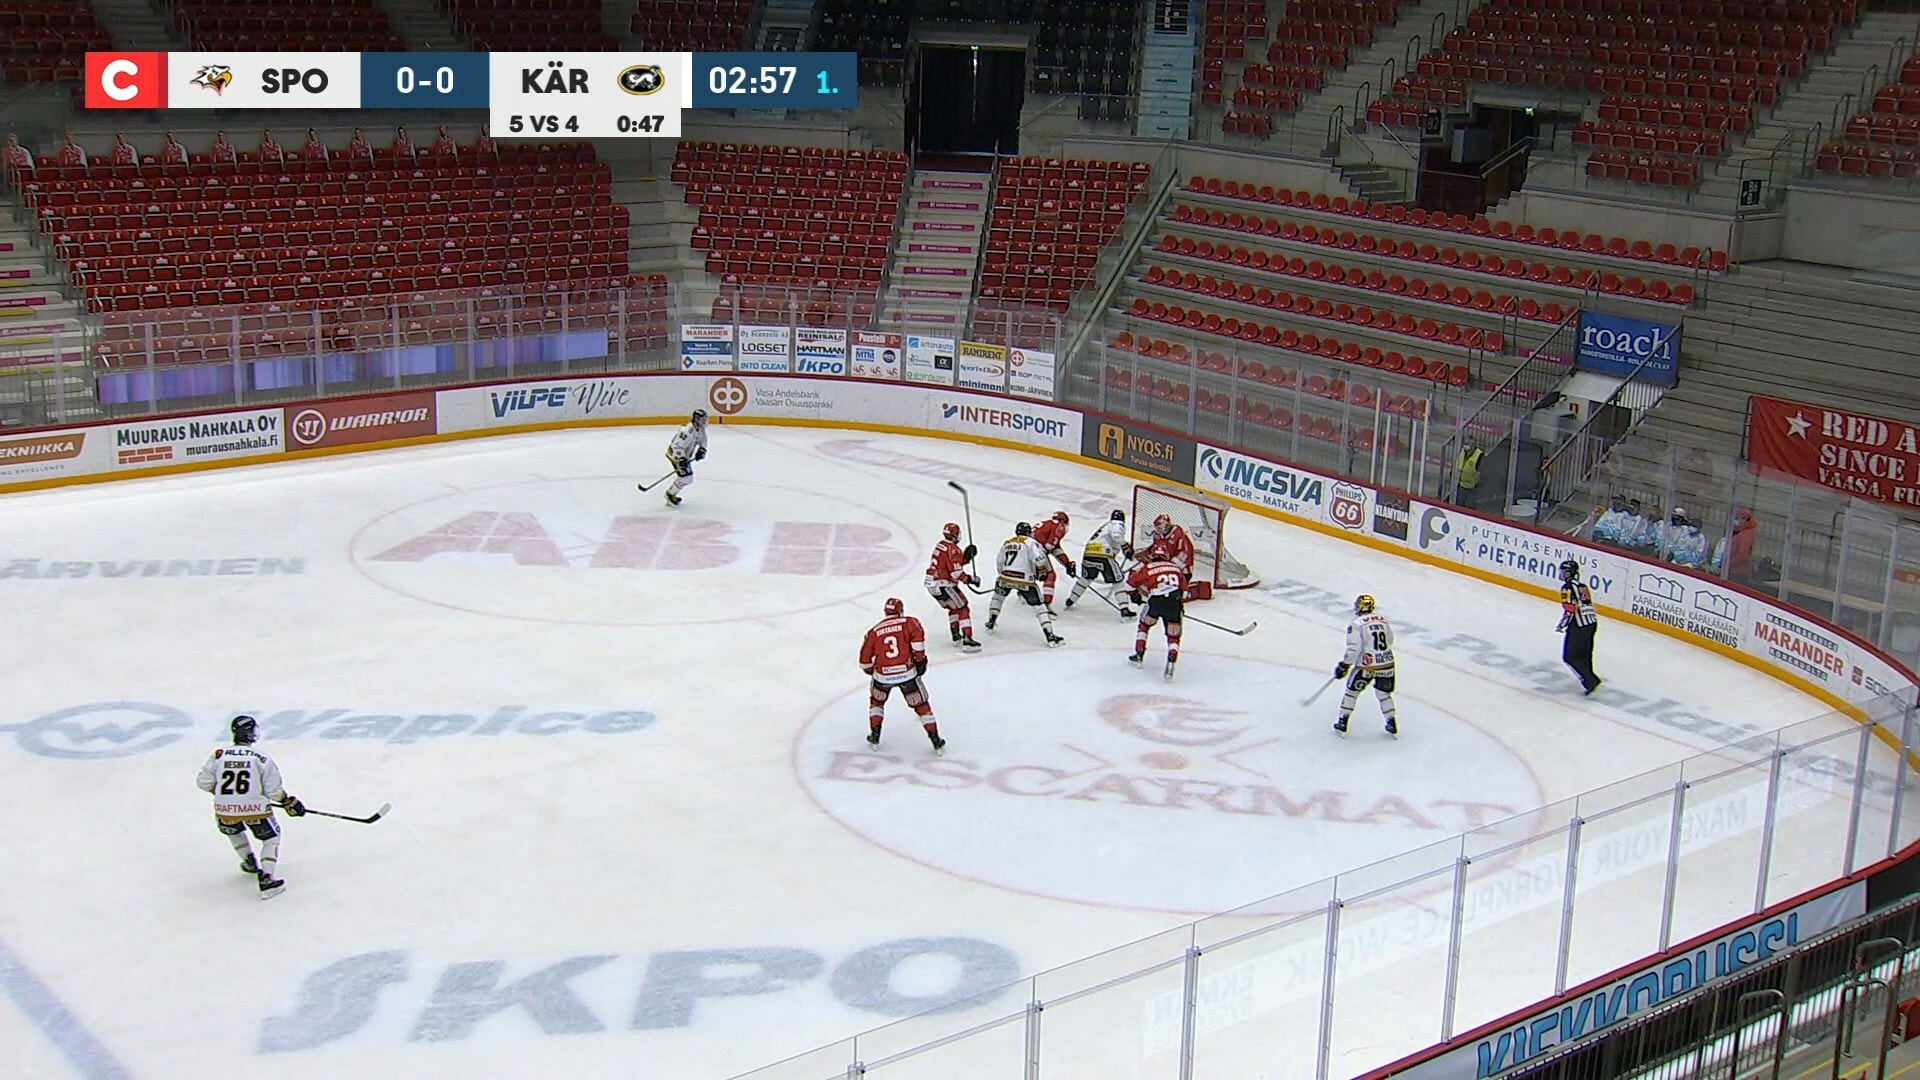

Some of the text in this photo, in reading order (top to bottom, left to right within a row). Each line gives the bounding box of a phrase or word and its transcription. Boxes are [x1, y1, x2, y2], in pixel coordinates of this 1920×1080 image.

[741, 342, 787, 353] LOGSET
[797, 345, 845, 354] HARTMAN
[962, 347, 1003, 360] RAMIRENT
[1581, 325, 1671, 360] roach
[740, 362, 787, 371] INTO CLEAN
[798, 358, 843, 374] SKPO
[755, 388, 821, 399] Vasa Andelsbank
[959, 379, 1005, 392] minimani
[490, 386, 568, 418] VILPE
[755, 397, 834, 409] Vaasan Osuuspankki
[117, 425, 187, 447] MUURAUS
[189, 417, 256, 438] NAHKALA
[330, 408, 428, 431] WARRIOR
[960, 404, 1068, 438] INTERSPORT
[1821, 410, 1920, 455] RED A
[185, 436, 279, 456] muurausnahkala.fi
[1127, 434, 1174, 461] NYQS.fi
[1820, 443, 1906, 482] SINCE
[1223, 457, 1322, 506] INGSVA
[1335, 486, 1363, 502] PHILLIPS
[1818, 467, 1887, 502] VAASA,
[1224, 484, 1253, 500] RESOR
[1263, 494, 1300, 513] MATKAT
[1335, 501, 1359, 521] 66
[365, 510, 912, 577] ABB
[1472, 525, 1598, 569] PUTKIASENNUS
[1455, 536, 1613, 594] K. PIETARIN OY
[1631, 604, 1685, 630] RAKENNUS
[883, 635, 900, 659] 3
[1371, 631, 1387, 651] 19
[1687, 623, 1738, 649] RAKENNUS
[1754, 621, 1844, 677] MARANDER
[225, 749, 268, 764] ALLTIME
[220, 770, 250, 795] 26
[822, 748, 1518, 835] ESCARMAT
[255, 935, 1024, 1055] SKPO
